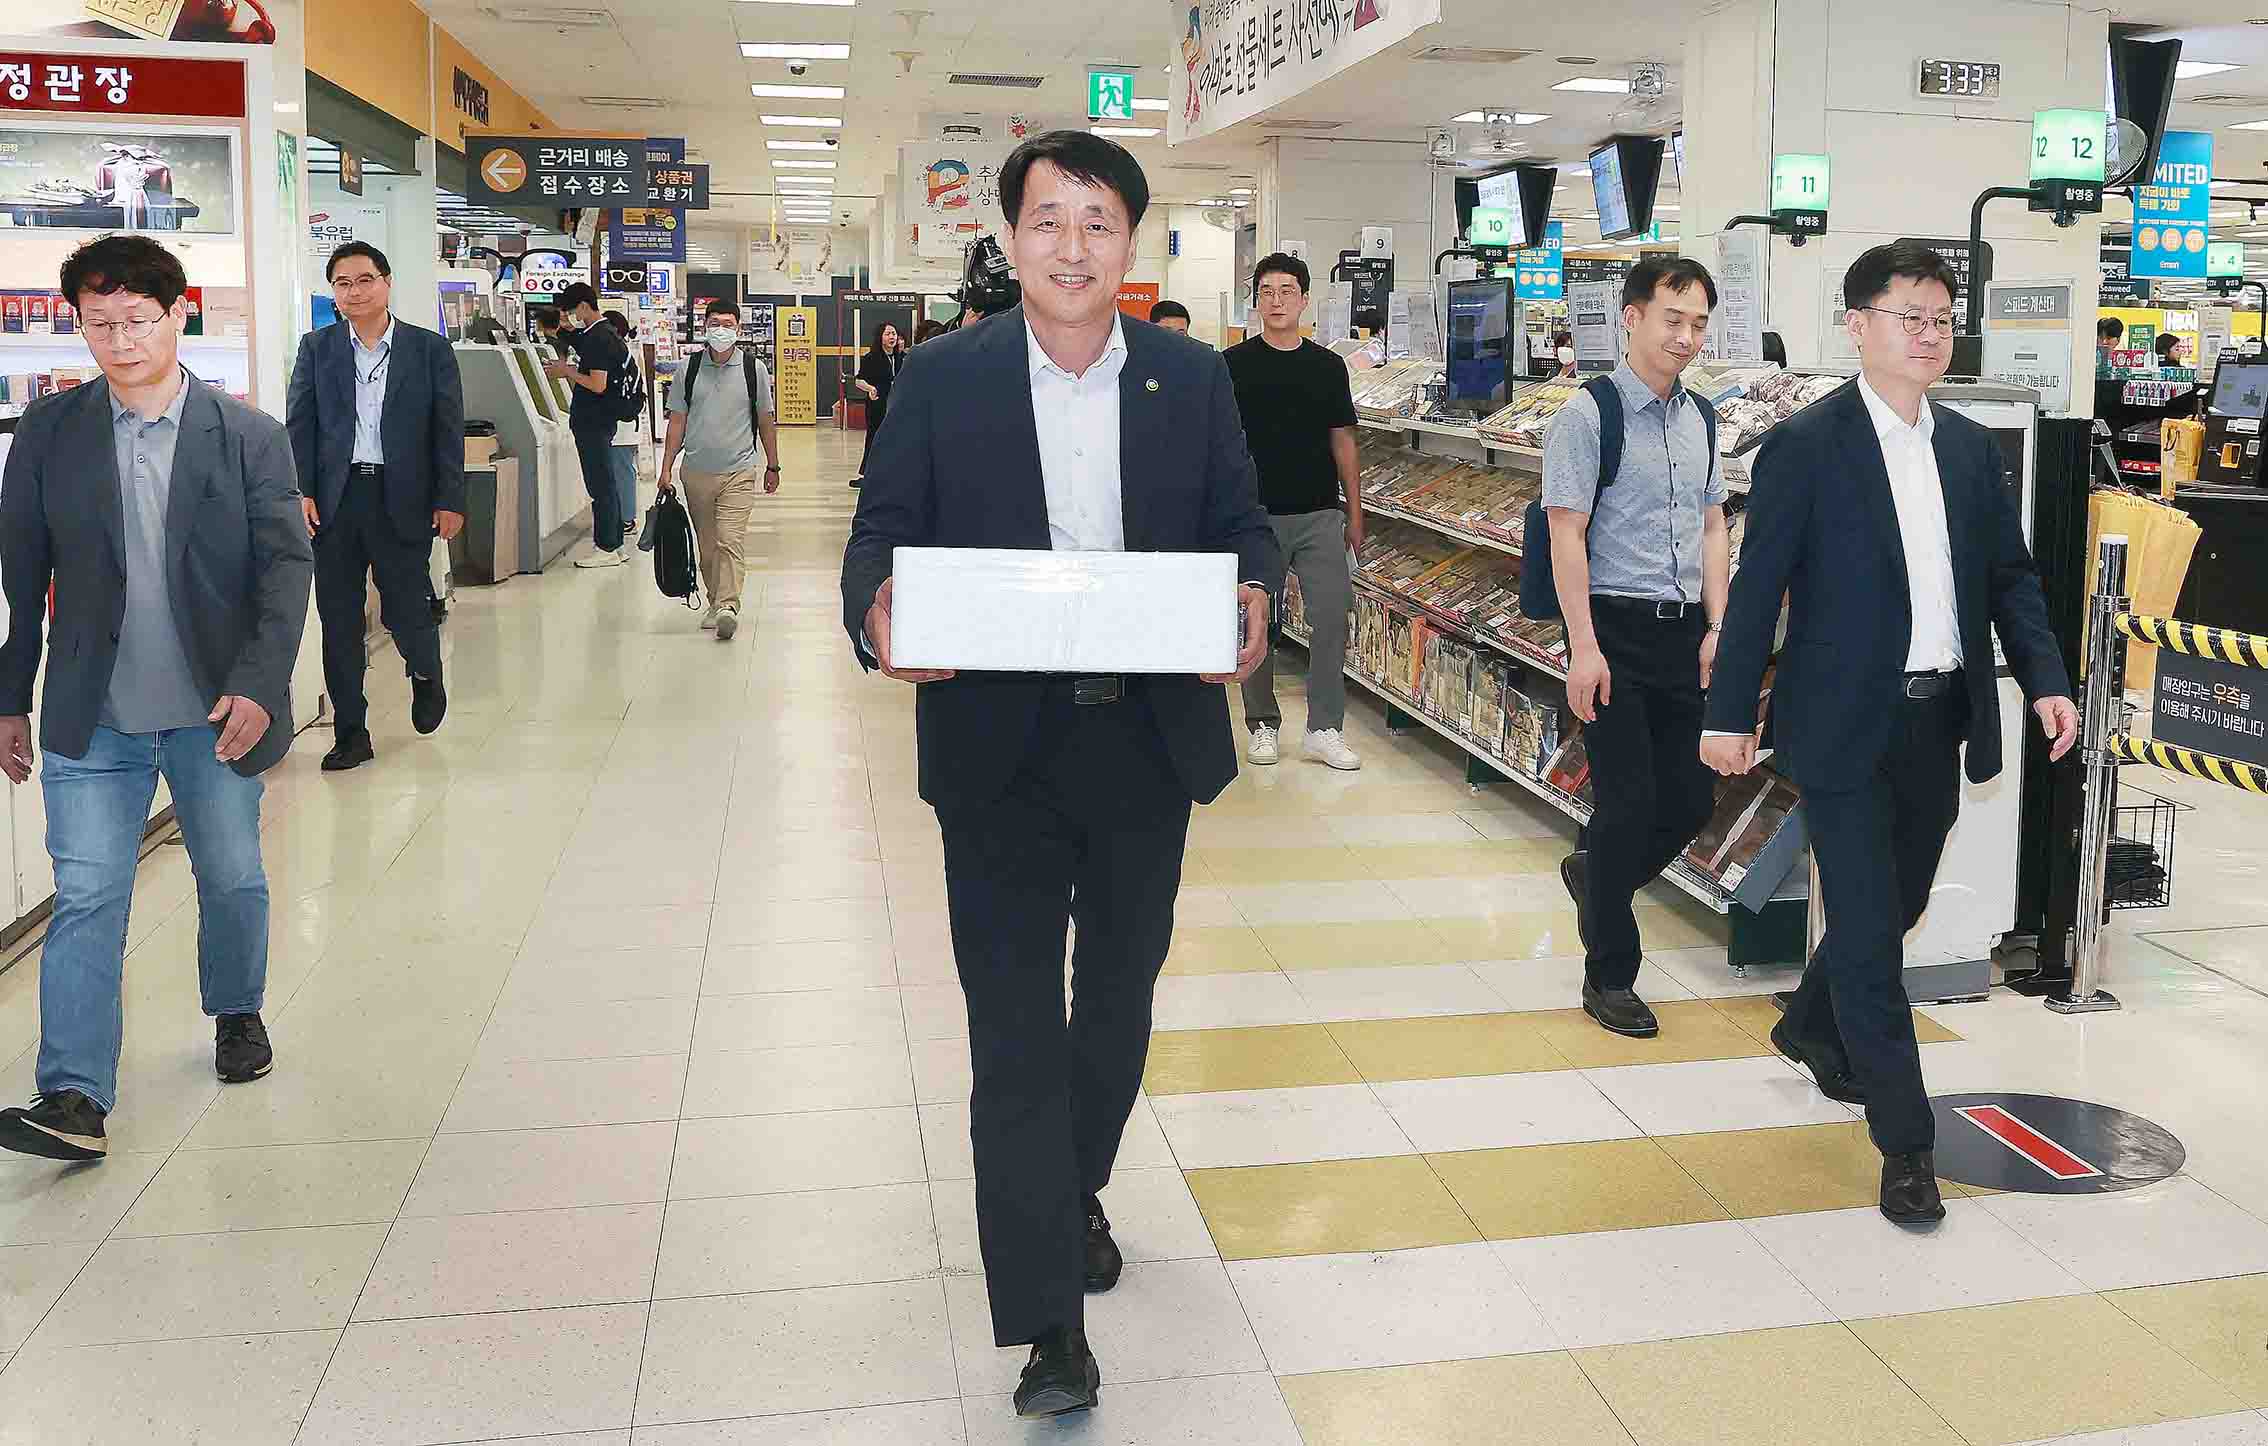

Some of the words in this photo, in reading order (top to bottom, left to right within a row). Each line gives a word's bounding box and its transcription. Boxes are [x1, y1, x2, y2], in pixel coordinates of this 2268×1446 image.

[1235, 5, 1286, 96] 선물세트
[1288, 0, 1353, 65] 사전예
[0, 63, 133, 105] 정관장
[2036, 136, 2048, 158] 12
[2072, 137, 2093, 159] 12
[538, 148, 590, 167] 근거리
[595, 148, 630, 168] 배송
[655, 170, 693, 186] 상품권
[2153, 163, 2209, 185] MITED
[1801, 175, 1815, 193] 11
[2065, 187, 2094, 201] 촬영중
[1487, 220, 1503, 233] 10
[1376, 238, 1385, 249] 9
[552, 271, 585, 279] Exchange
[2003, 296, 2029, 313] 스피드
[2161, 676, 2211, 702] 매장입구는
[2212, 683, 2251, 711] 우측을
[2160, 698, 2190, 720] 이용해
[2191, 705, 2221, 728] 주시기
[2222, 712, 2265, 738] 바랍니다
